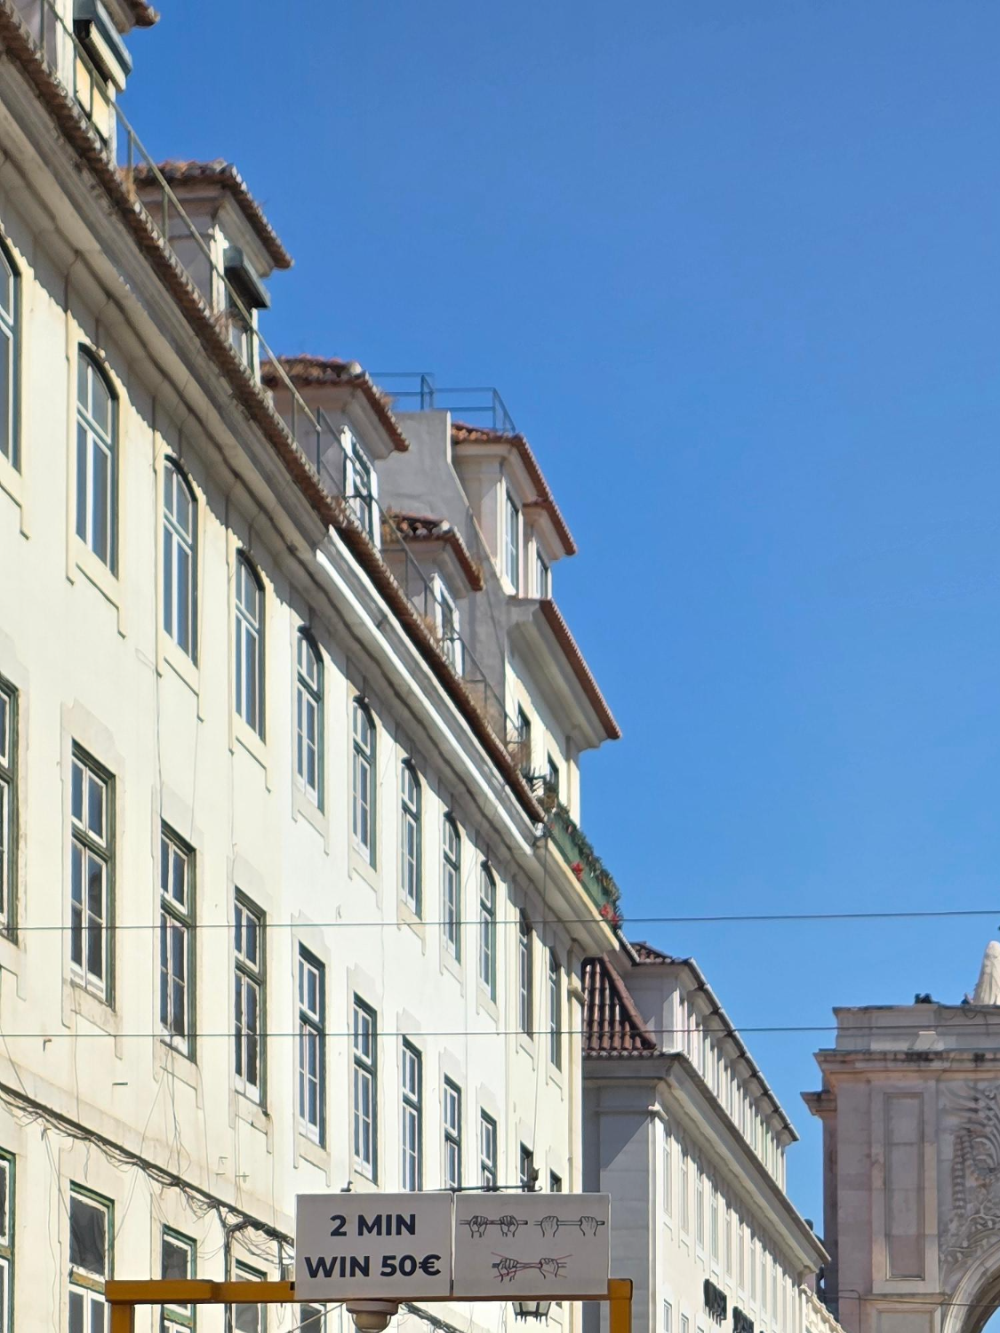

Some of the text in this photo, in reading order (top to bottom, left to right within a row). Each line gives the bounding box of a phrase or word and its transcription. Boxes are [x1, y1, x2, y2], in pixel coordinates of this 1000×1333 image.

[330, 1213, 416, 1237] 2 MIN
[304, 1254, 442, 1278] WIN 50€
